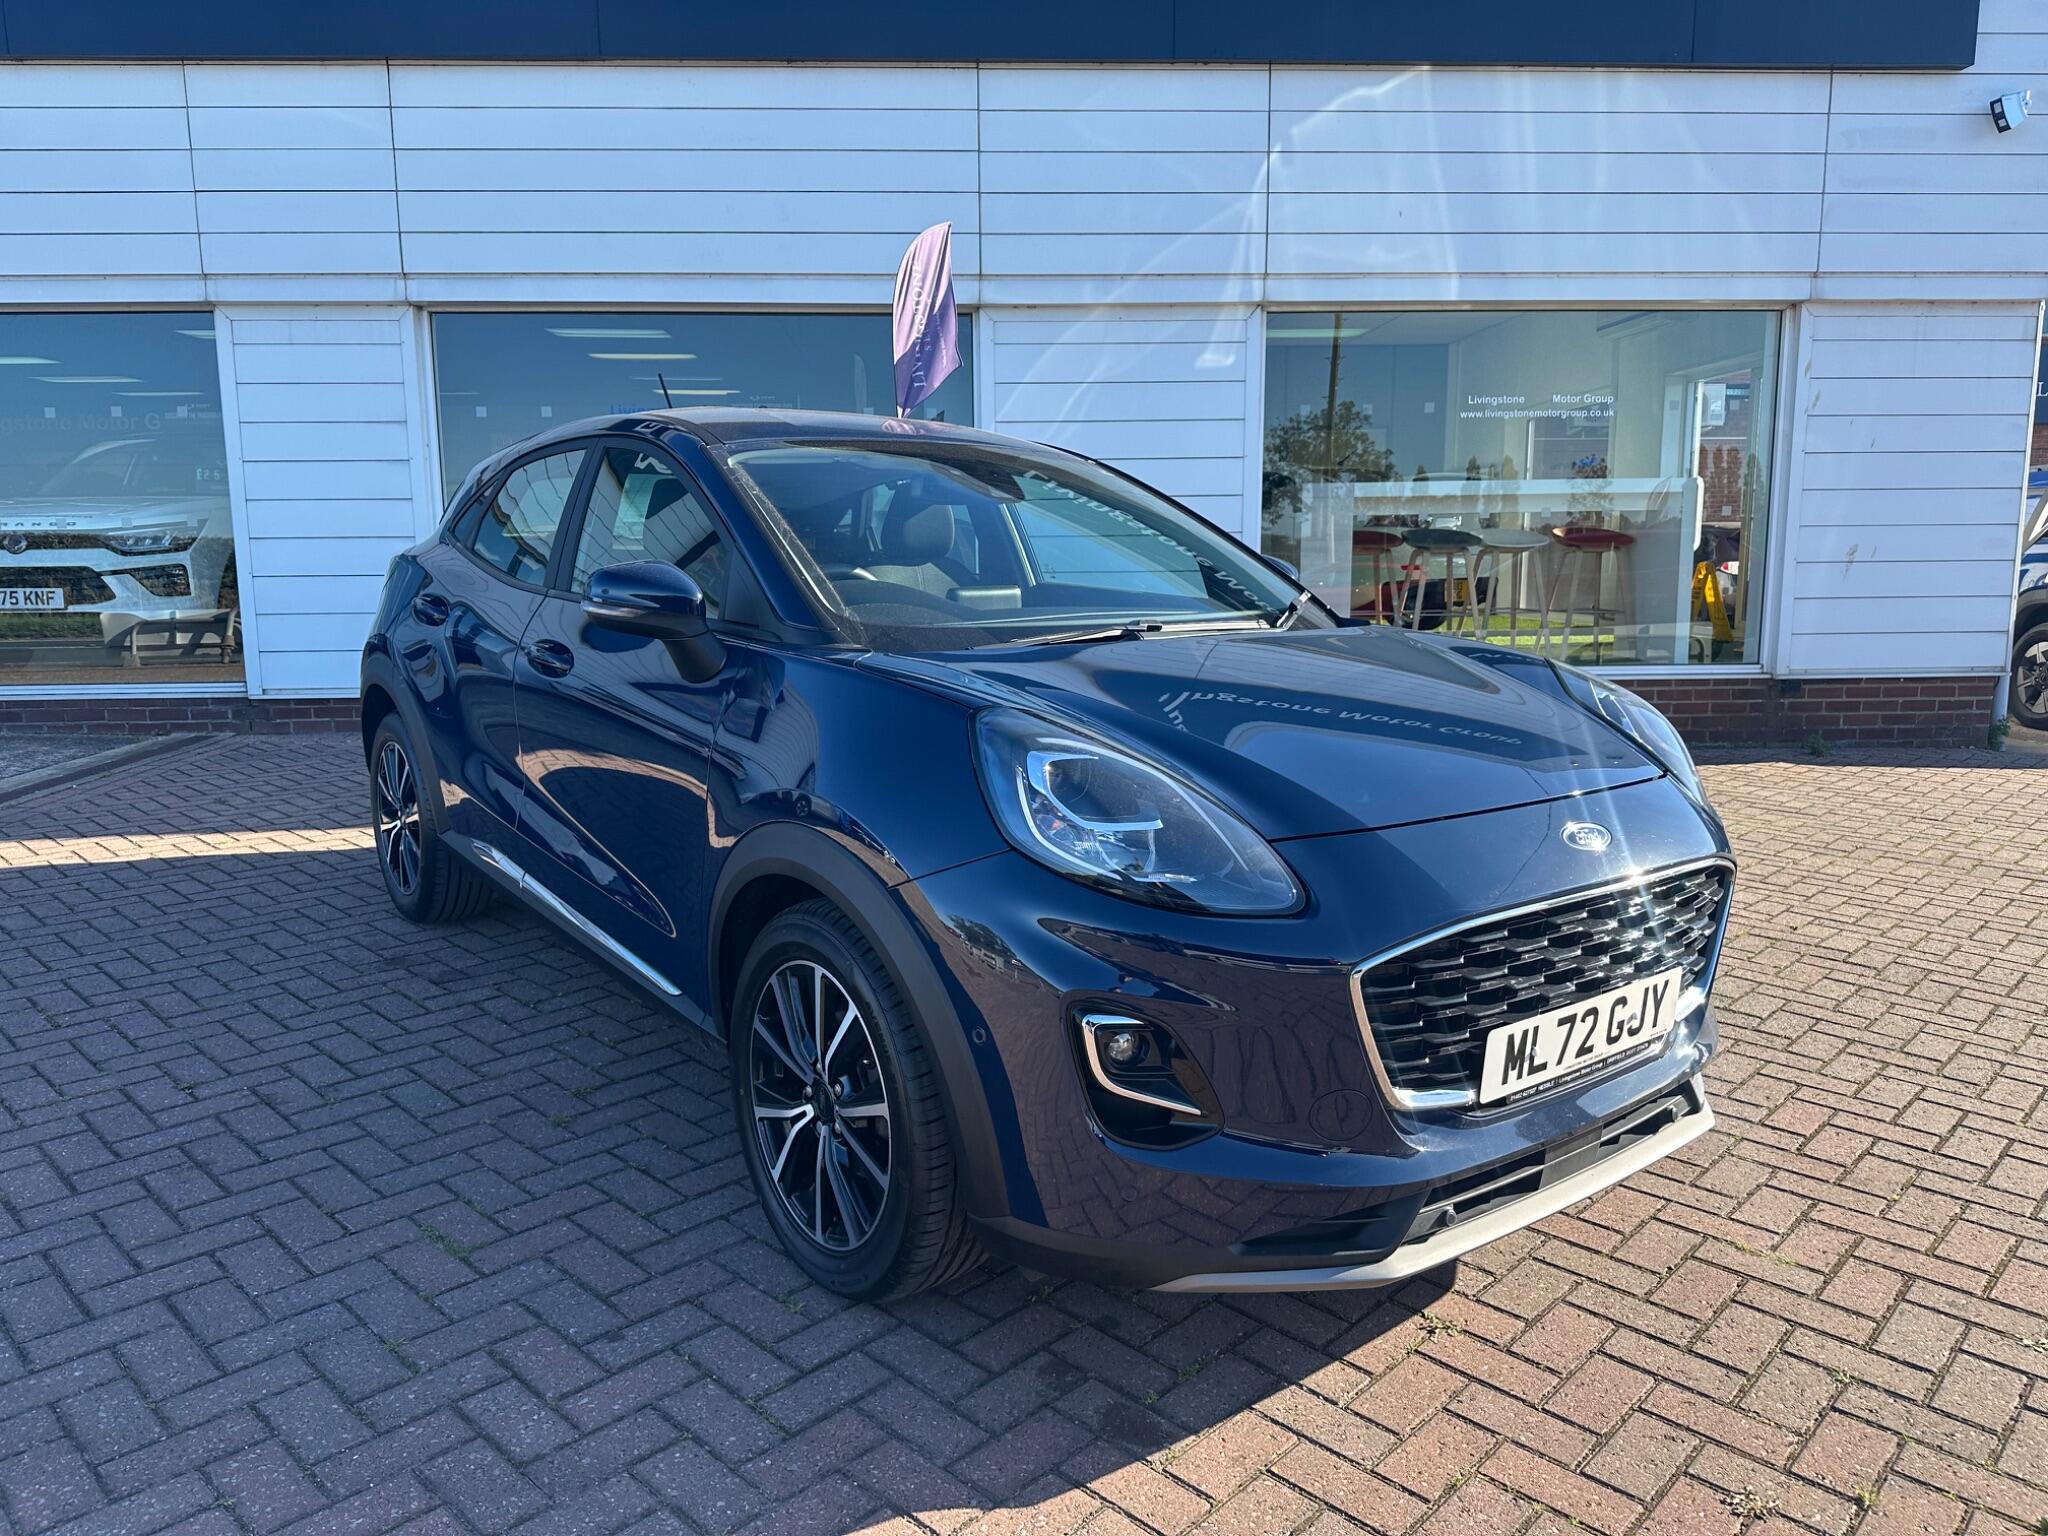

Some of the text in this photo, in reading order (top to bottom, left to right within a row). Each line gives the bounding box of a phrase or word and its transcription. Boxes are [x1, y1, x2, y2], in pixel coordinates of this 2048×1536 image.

[1468, 393, 1614, 406] Livingstone Motor Group
[1459, 408, 1615, 419] www.livingstonemotorgroup.co.uk
[23, 590, 56, 606] KNF
[1606, 979, 1670, 1046] GJY
